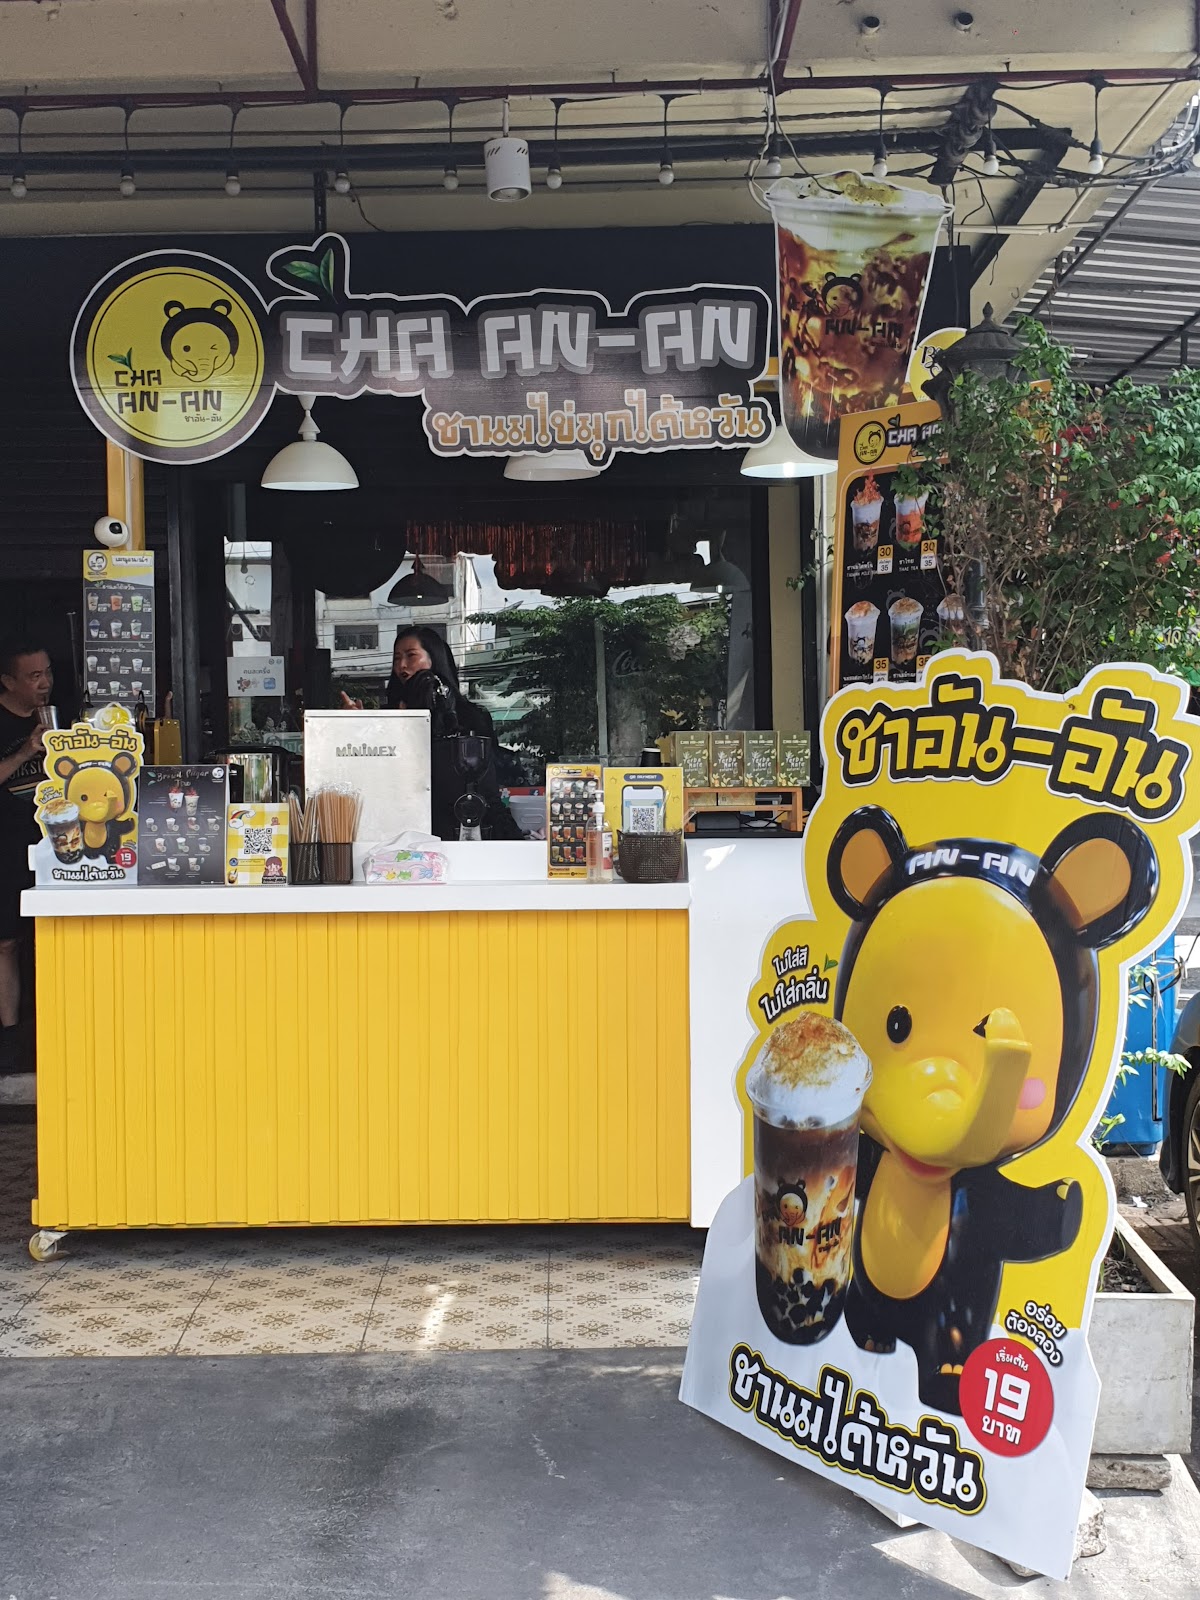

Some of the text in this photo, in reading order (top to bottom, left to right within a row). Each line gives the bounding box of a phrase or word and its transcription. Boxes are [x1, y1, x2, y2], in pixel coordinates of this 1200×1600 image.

[286, 305, 751, 377] CHA AN-AN
[114, 369, 162, 387] CHA
[116, 389, 223, 415] AN-AN
[431, 388, 767, 461] ชานมไข่มุกไต้หวัน
[888, 427, 917, 444] CHA
[879, 546, 892, 557] 30
[923, 542, 936, 552] 30
[880, 563, 889, 572] 35
[923, 559, 933, 567] 35
[875, 660, 887, 670] 35
[50, 729, 138, 751] ชาอัน-อัน
[841, 682, 1179, 810] ชาอัน-อัน
[120, 852, 132, 862] 19
[908, 847, 1036, 887] AN-AN
[52, 865, 126, 881] ชานมไต้หวัน
[759, 966, 829, 1021] ไม่ใส่กลิ่น
[778, 1216, 842, 1247] AN-AN
[1024, 1301, 1068, 1338] อร่อย
[1005, 1311, 1063, 1365] ต้องลอง
[995, 1346, 1029, 1372] เริ่มต้น
[984, 1367, 1031, 1423] 19
[733, 1351, 979, 1503] ชานมไต้หวัน
[981, 1415, 1022, 1445] บาท
